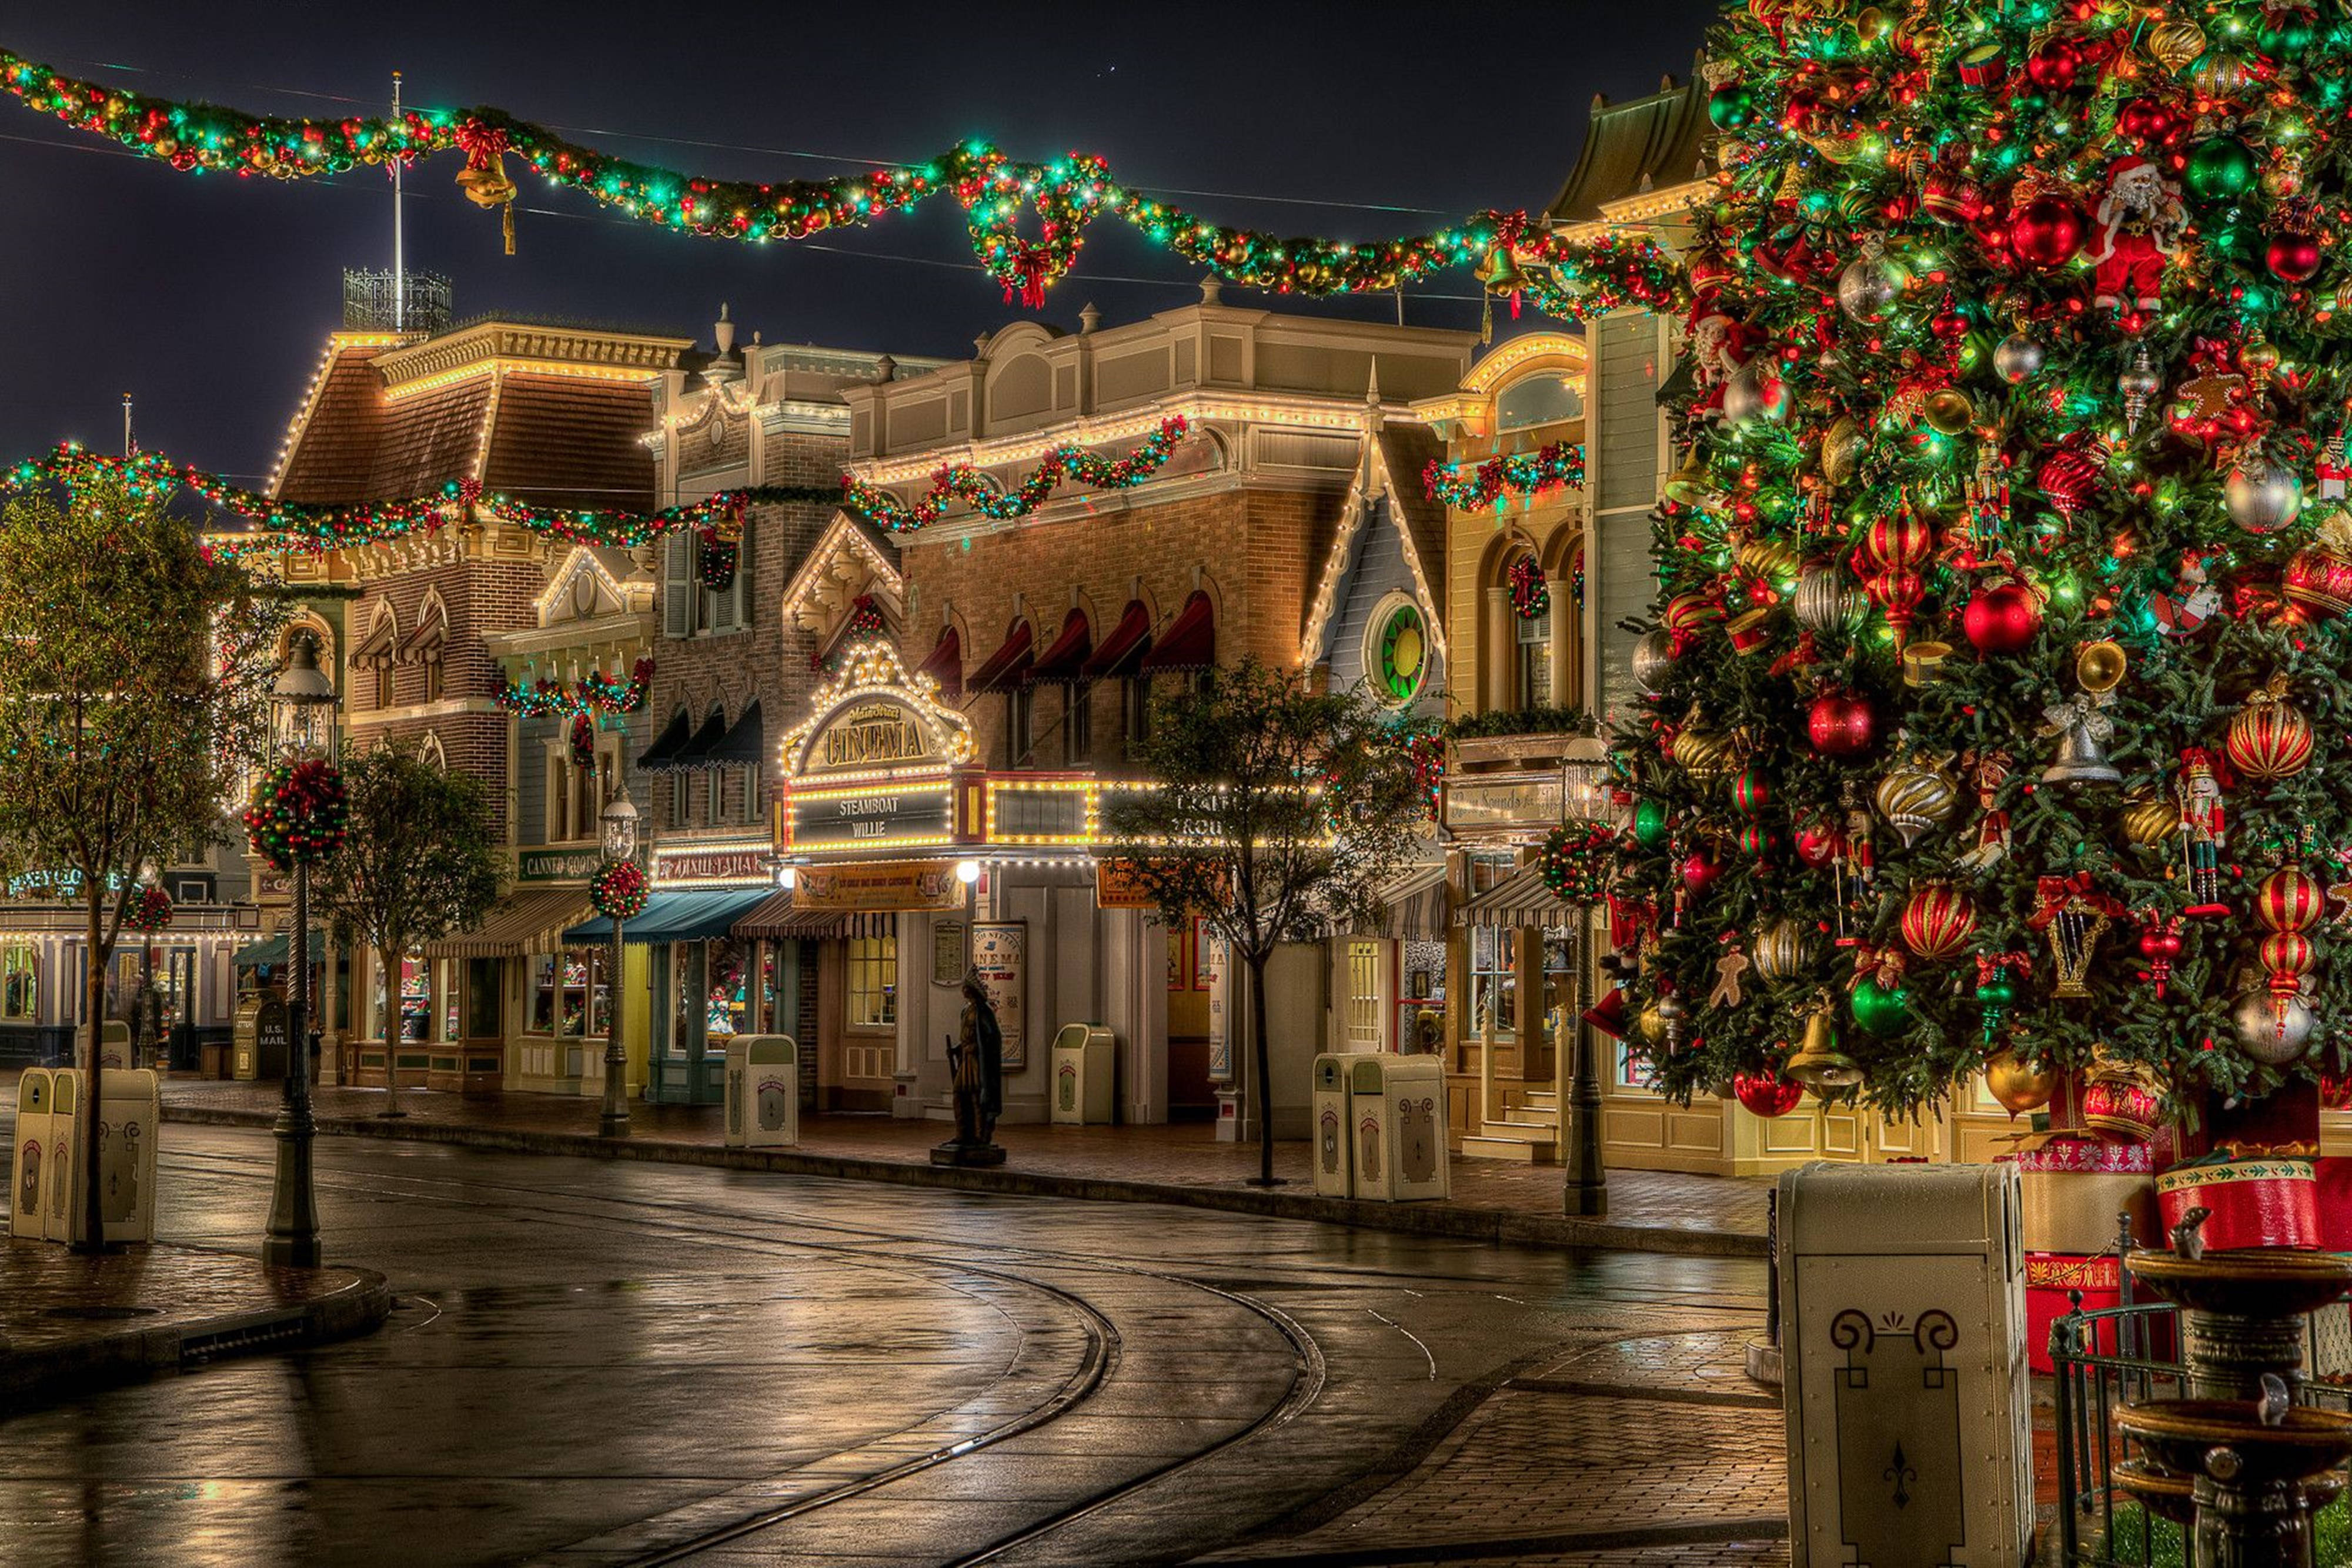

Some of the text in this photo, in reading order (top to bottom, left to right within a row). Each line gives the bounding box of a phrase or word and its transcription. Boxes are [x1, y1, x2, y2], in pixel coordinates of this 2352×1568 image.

[824, 718, 925, 767] CINEMA
[840, 797, 898, 816] STEAMBOAT
[853, 821, 886, 838] WILLIE
[527, 857, 564, 875] CANNED
[974, 953, 1021, 964] INEMA
[265, 1025, 284, 1034] U.S.
[260, 1036, 288, 1045] MAIL
